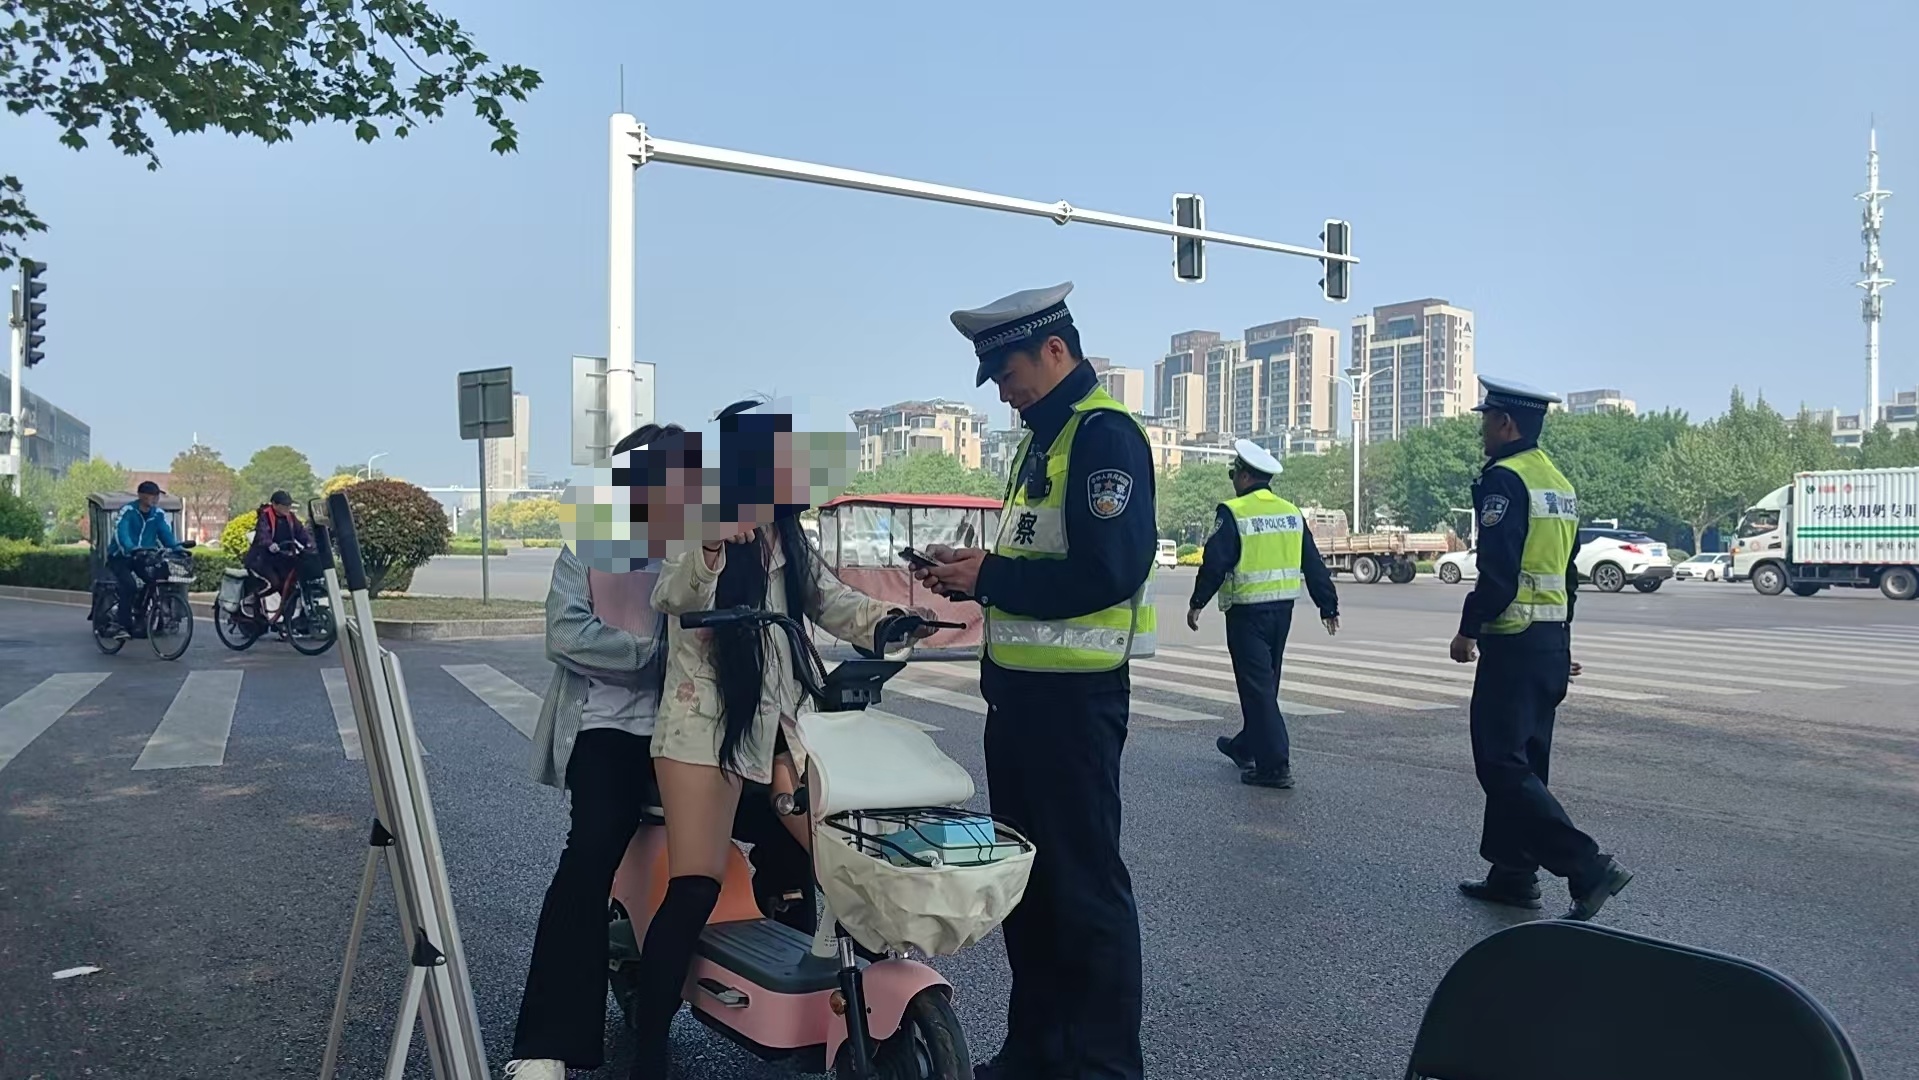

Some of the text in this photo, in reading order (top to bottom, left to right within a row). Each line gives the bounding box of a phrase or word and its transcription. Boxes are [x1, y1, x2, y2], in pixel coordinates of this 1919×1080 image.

[1544, 492, 1559, 515] 警
[1813, 503, 1918, 519] 学生饮用奶专用
[1013, 511, 1038, 545] 察
[1264, 518, 1287, 529] POLICE
[1286, 515, 1298, 529] 察
